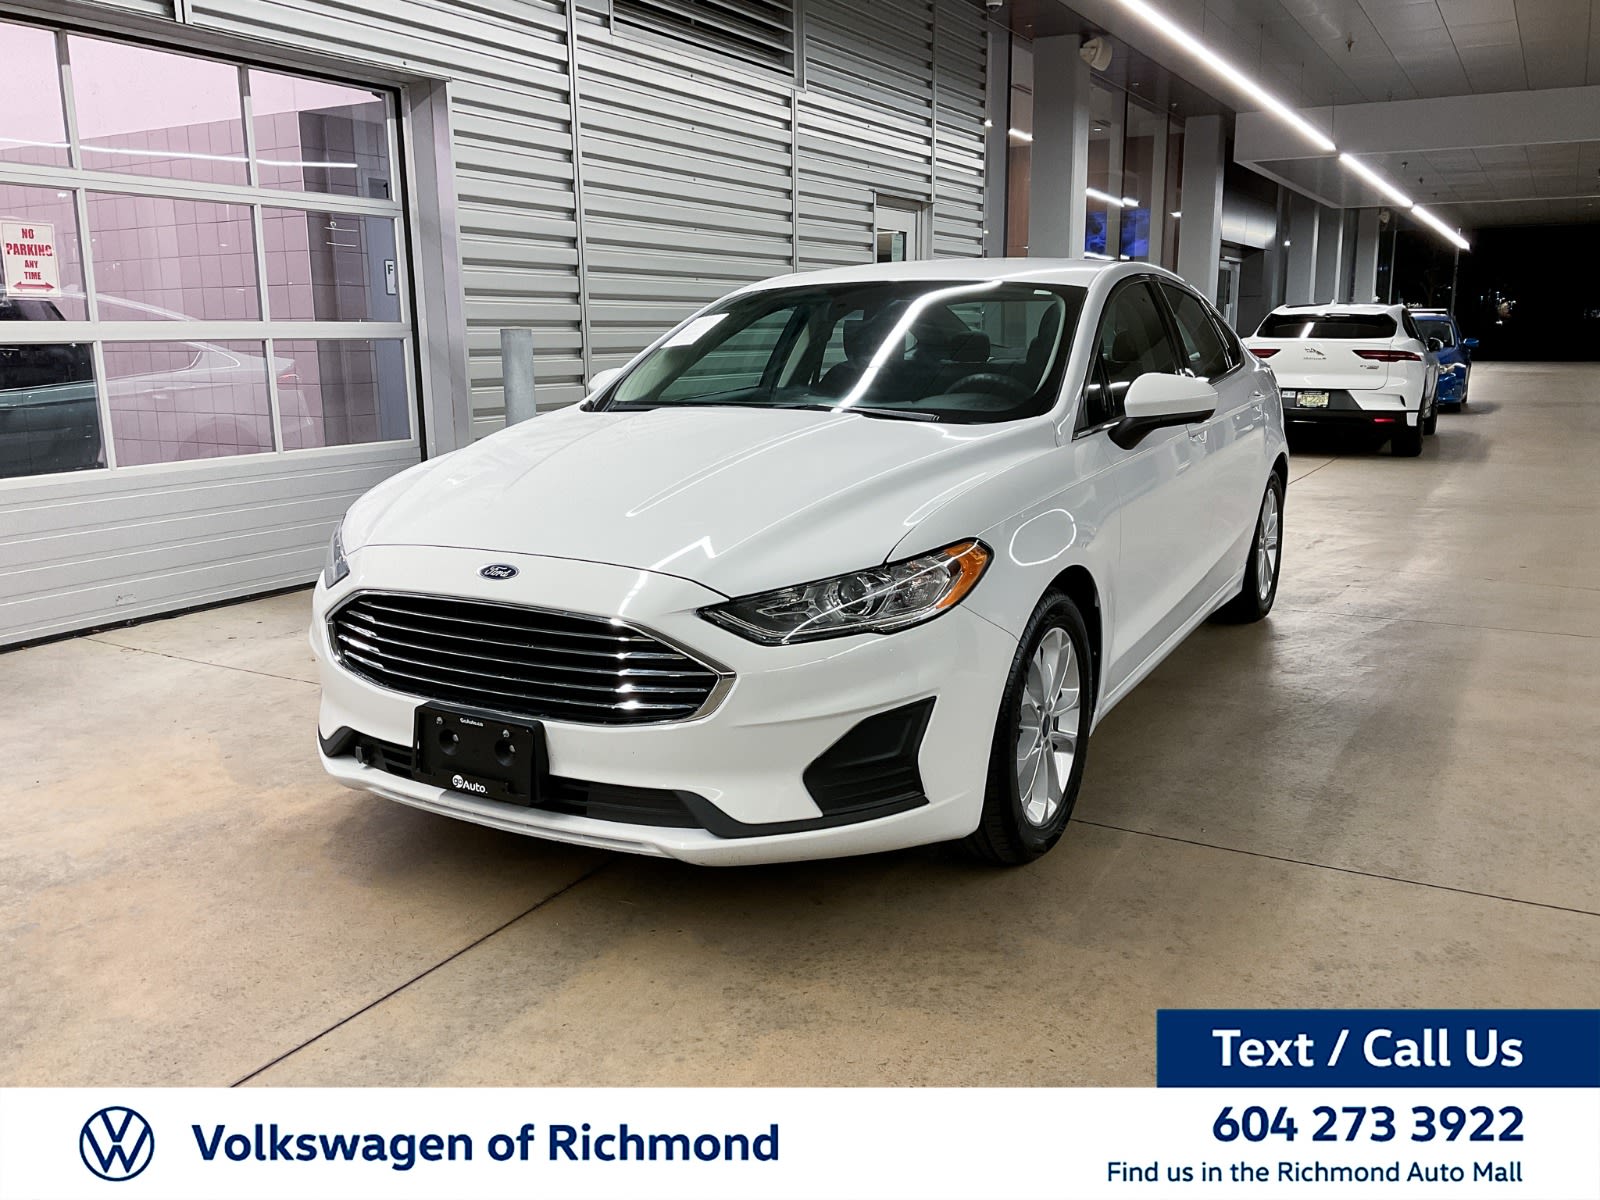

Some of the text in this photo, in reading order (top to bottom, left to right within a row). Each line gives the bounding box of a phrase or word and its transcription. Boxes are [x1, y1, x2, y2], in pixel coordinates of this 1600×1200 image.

[21, 228, 34, 239] NO
[5, 242, 53, 257] PARKING
[24, 259, 38, 269] ANY
[23, 271, 42, 280] TIME
[484, 566, 512, 577] Ford
